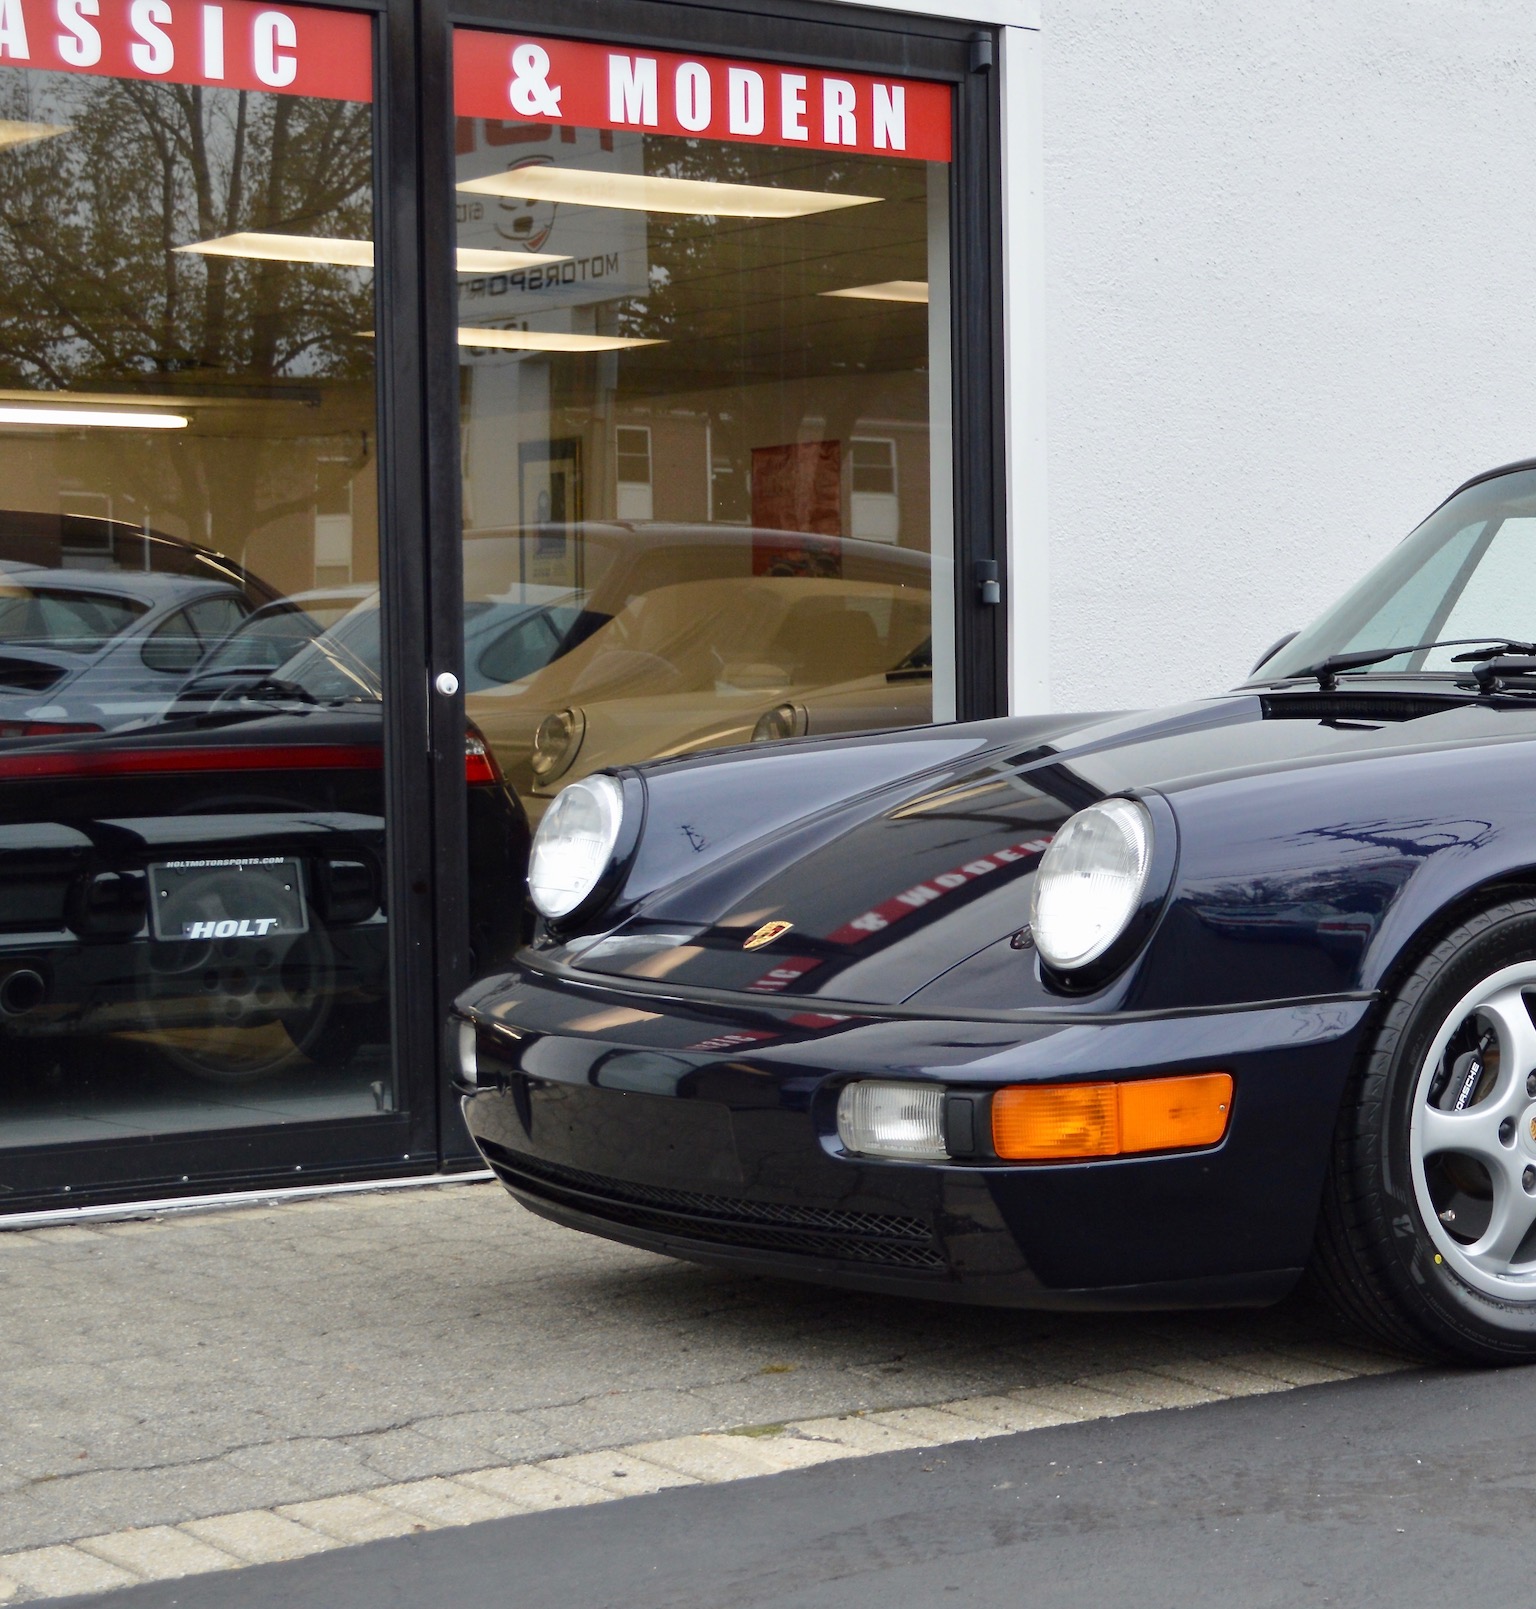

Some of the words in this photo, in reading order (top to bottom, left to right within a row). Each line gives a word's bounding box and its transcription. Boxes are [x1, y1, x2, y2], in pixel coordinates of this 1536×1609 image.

[509, 43, 563, 117] &
[608, 54, 907, 151] MODERN
[167, 857, 285, 868] HOLTMOTORSPORTS.COM
[190, 918, 277, 939] HOLT
[1454, 1061, 1480, 1112] ORSCHE
